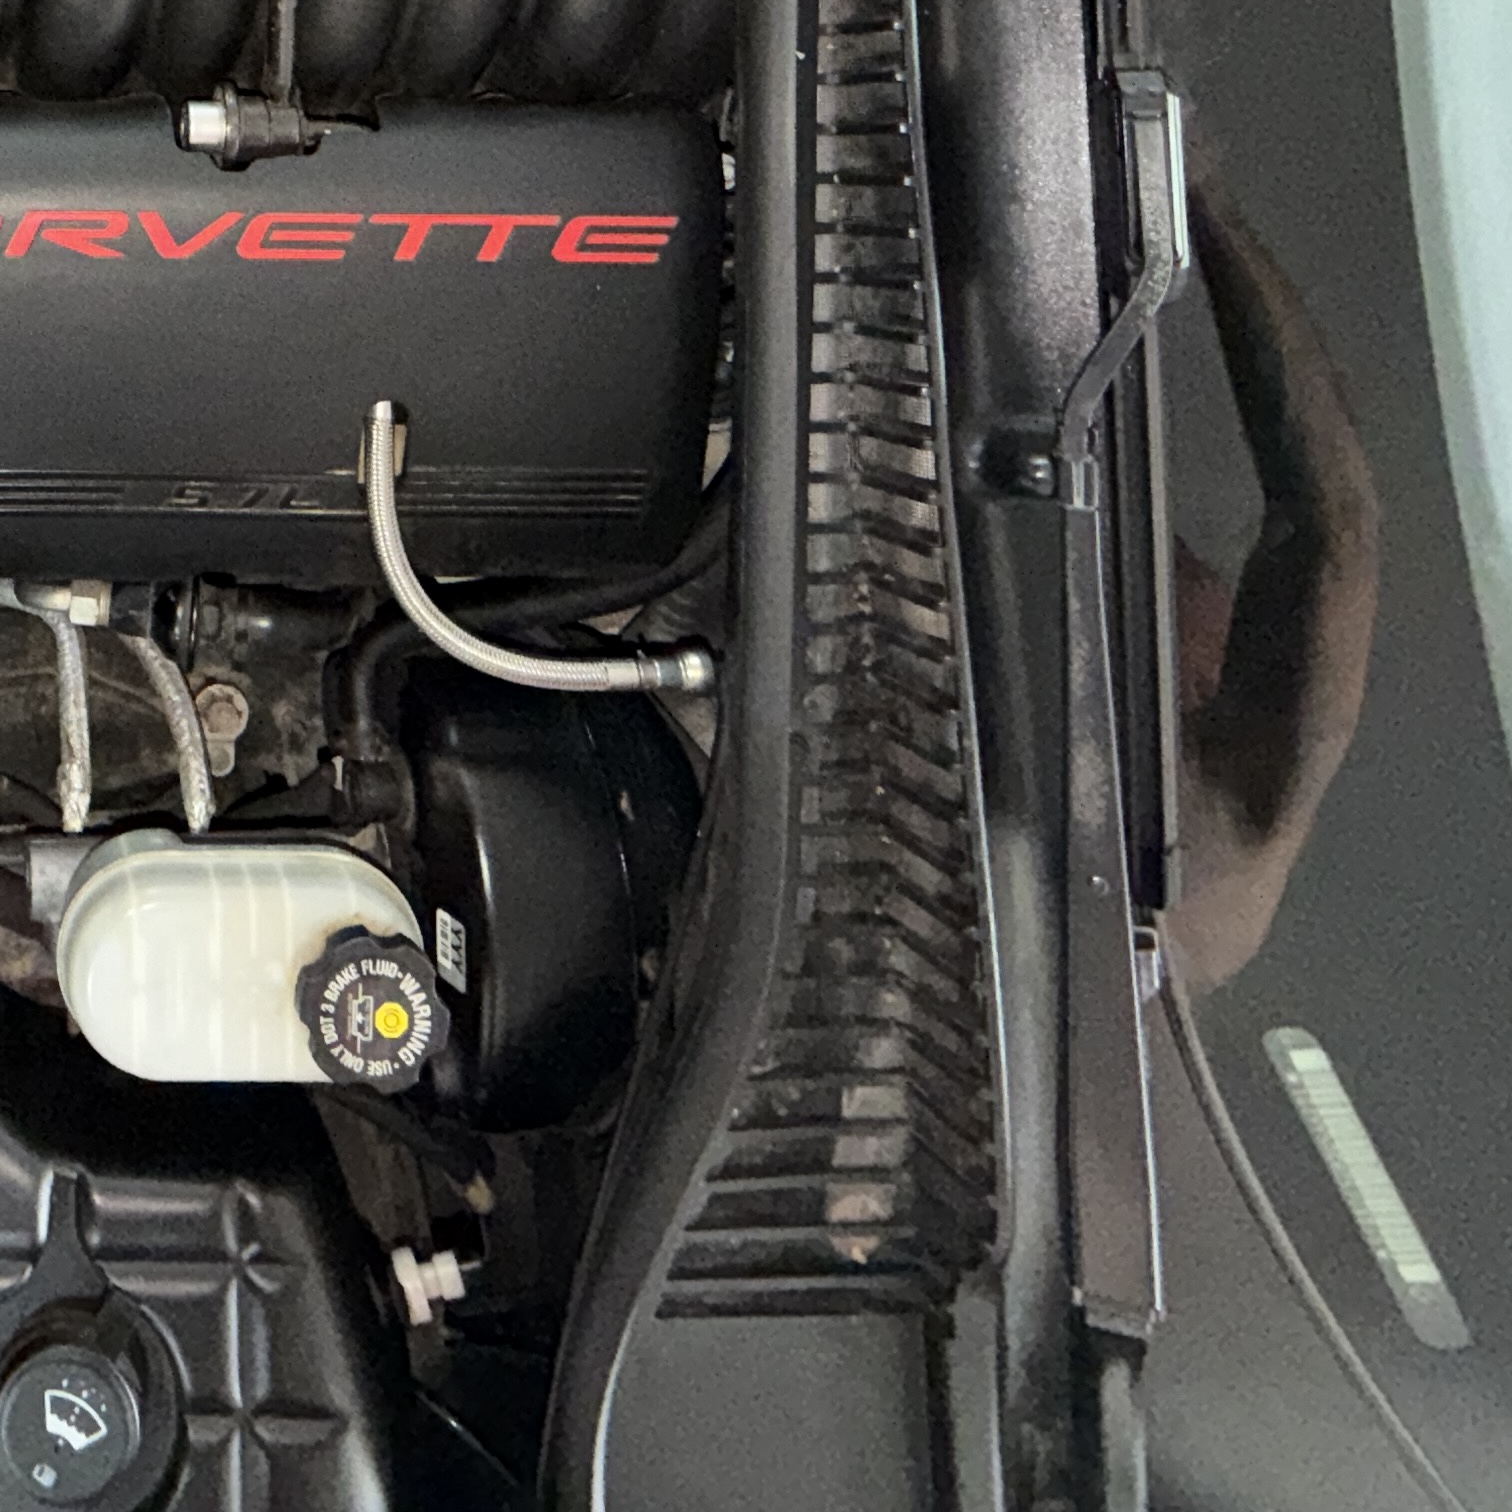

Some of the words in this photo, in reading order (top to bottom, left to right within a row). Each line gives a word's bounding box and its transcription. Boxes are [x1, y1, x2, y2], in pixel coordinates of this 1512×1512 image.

[324, 963, 360, 1003] BRAKE
[360, 959, 399, 978] FLUID
[320, 1002, 335, 1014] 3
[399, 972, 432, 1067] WARNING
[320, 1016, 338, 1045] DOT
[330, 1043, 364, 1074] ONLY
[367, 1060, 393, 1076] USE
